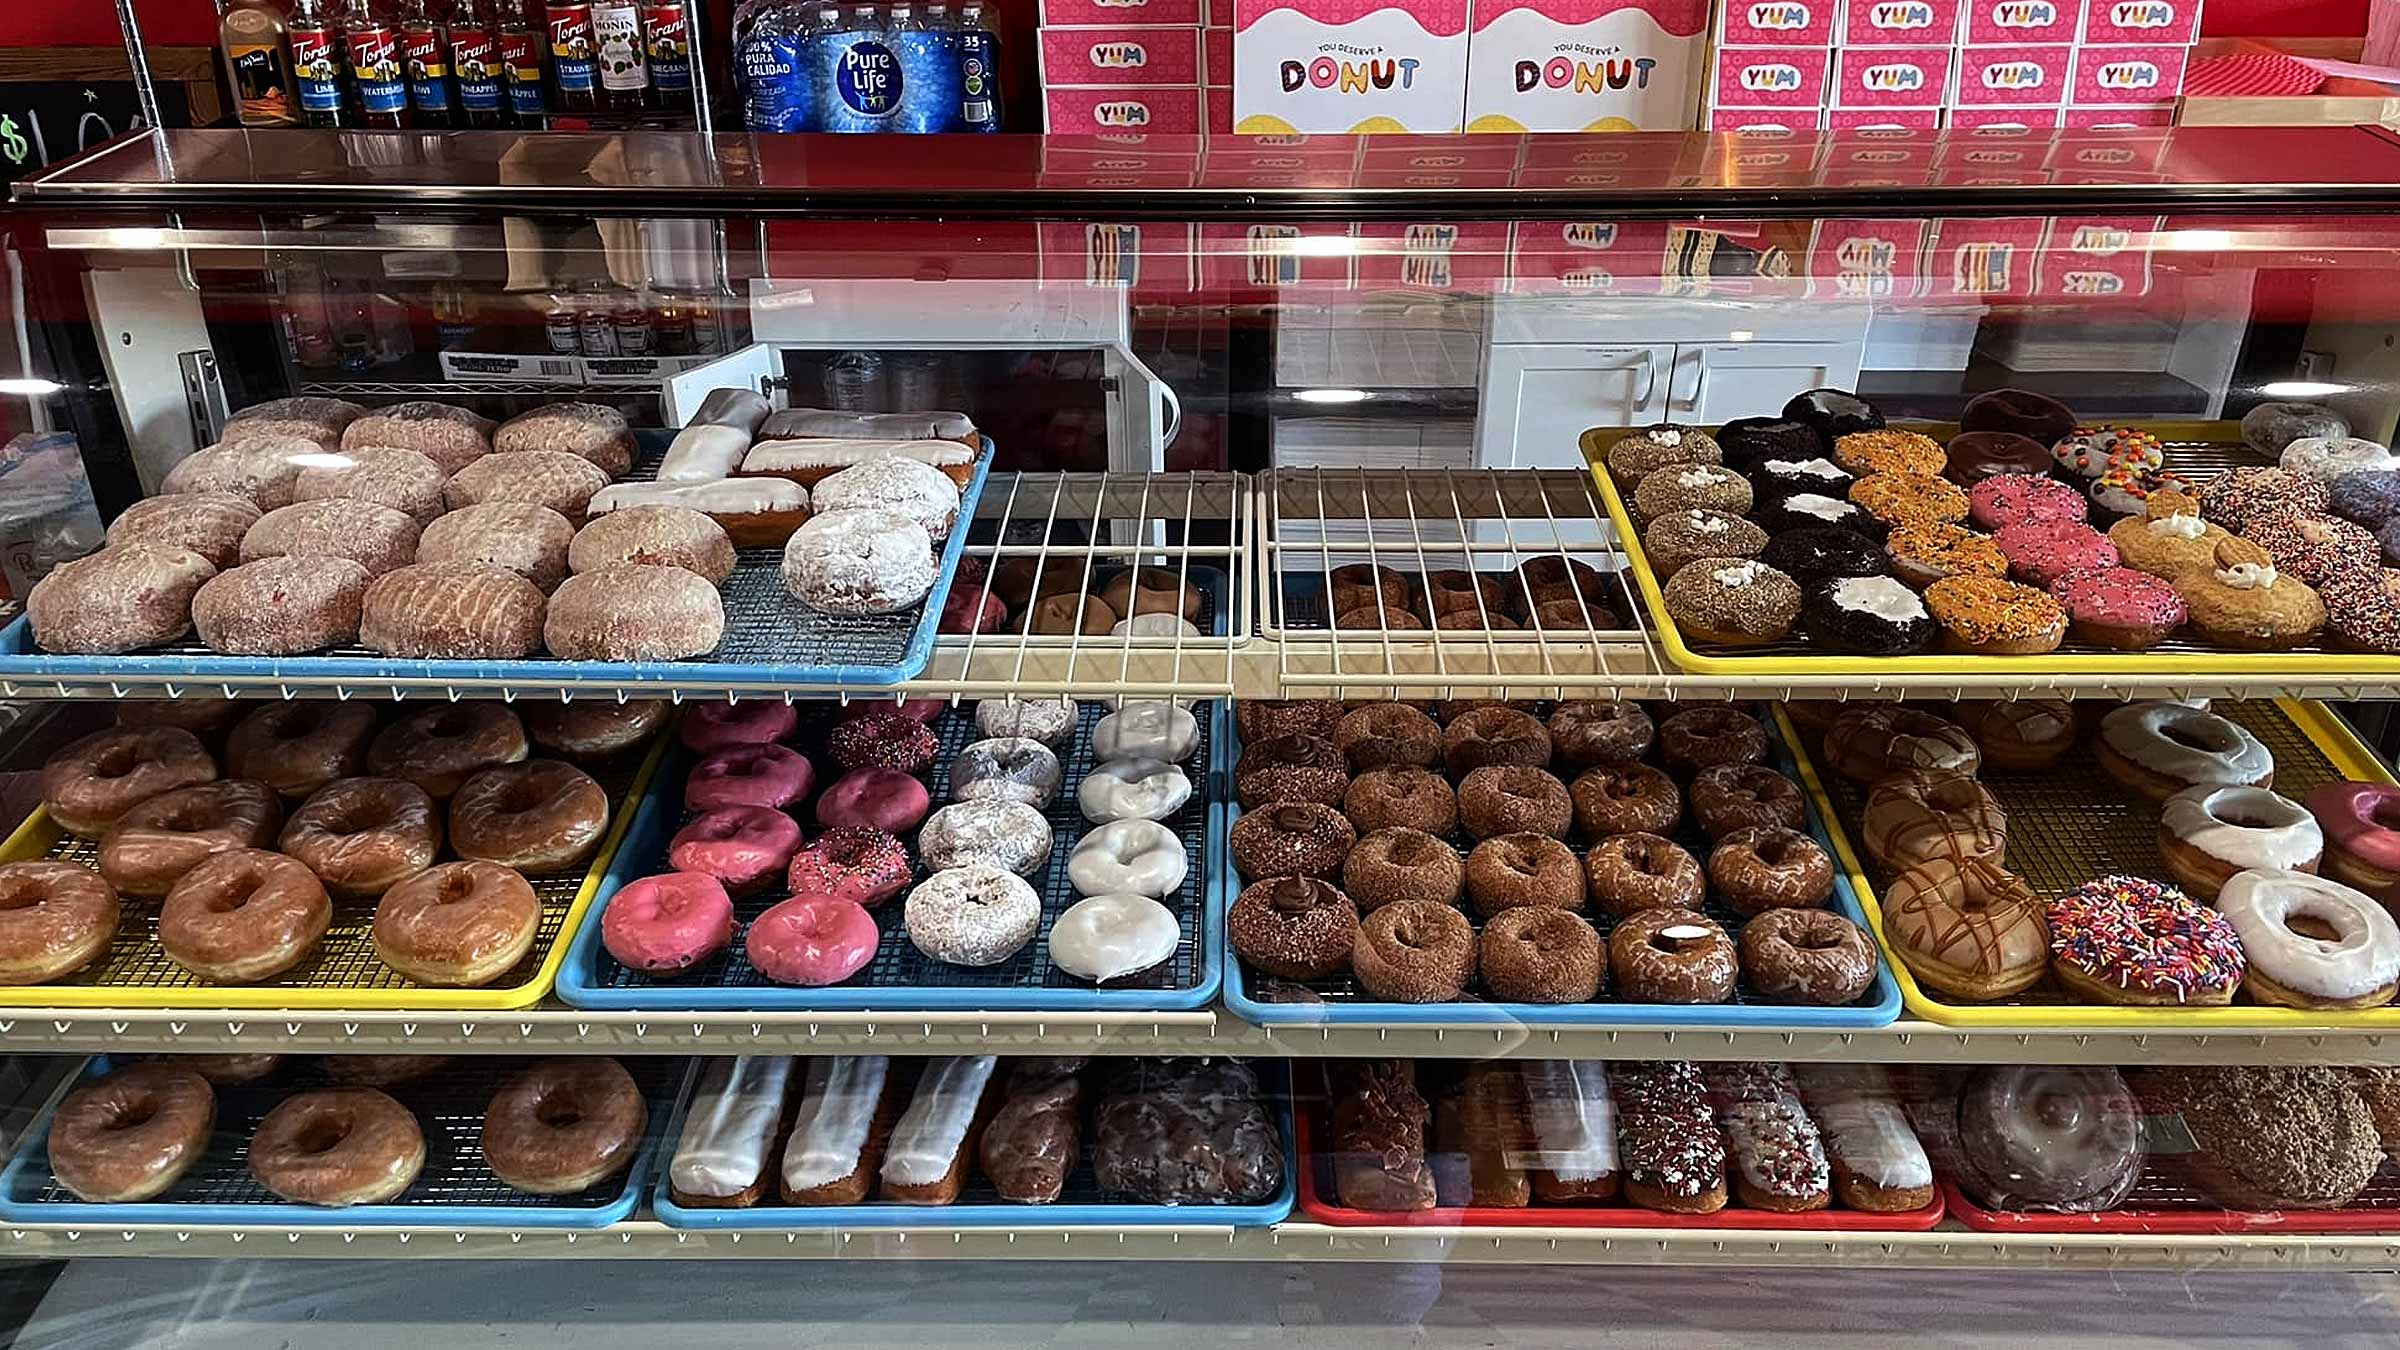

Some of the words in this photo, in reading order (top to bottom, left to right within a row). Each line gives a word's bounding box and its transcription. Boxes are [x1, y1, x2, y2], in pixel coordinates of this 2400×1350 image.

[1756, 7, 1804, 25] YUM
[1878, 6, 1928, 24] YUM
[2000, 4, 2051, 23] YUM
[2118, 5, 2168, 23] YUM
[551, 18, 591, 44] Toran
[594, 20, 634, 30] MONIN
[643, 15, 687, 42] Torani
[451, 37, 493, 64] Torani
[964, 36, 980, 47] 35
[1318, 43, 1337, 53] YOU
[1338, 43, 1376, 56] DESERVE
[1554, 43, 1573, 53] YOU
[1574, 43, 1612, 56] DESERVE
[355, 41, 396, 67] Toran
[745, 53, 775, 65] PURA
[846, 50, 890, 70] Pure
[1096, 47, 1142, 64] YUM
[747, 63, 791, 76] CALIDAD
[1281, 56, 1420, 94] DONUT
[1515, 56, 1657, 94] DONUT
[1748, 69, 1796, 86] YUM
[1870, 69, 1918, 86] YUM
[1990, 66, 2038, 84] YUM
[2105, 66, 2154, 84] YUM
[853, 70, 887, 93] Life
[1100, 106, 1146, 122] YUM
